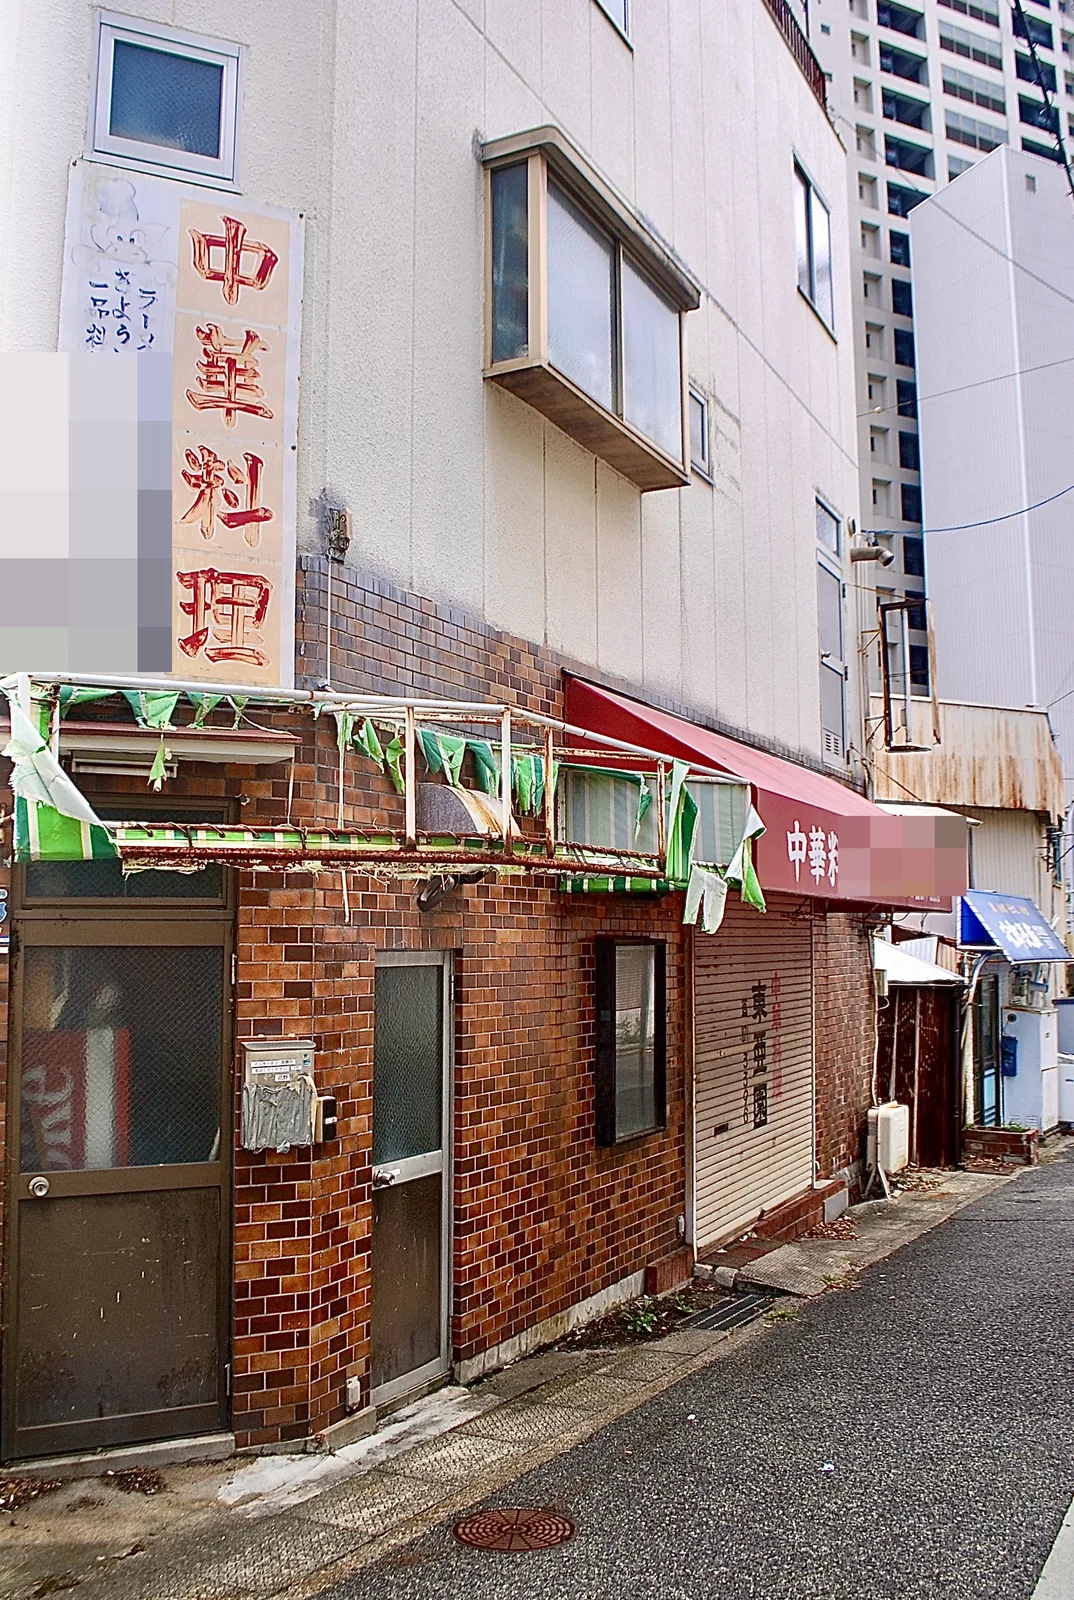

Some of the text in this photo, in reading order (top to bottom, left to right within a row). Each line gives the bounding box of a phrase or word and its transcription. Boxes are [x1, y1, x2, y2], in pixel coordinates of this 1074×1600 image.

[85, 281, 110, 352] 一品料
[175, 214, 280, 667] 中華料理
